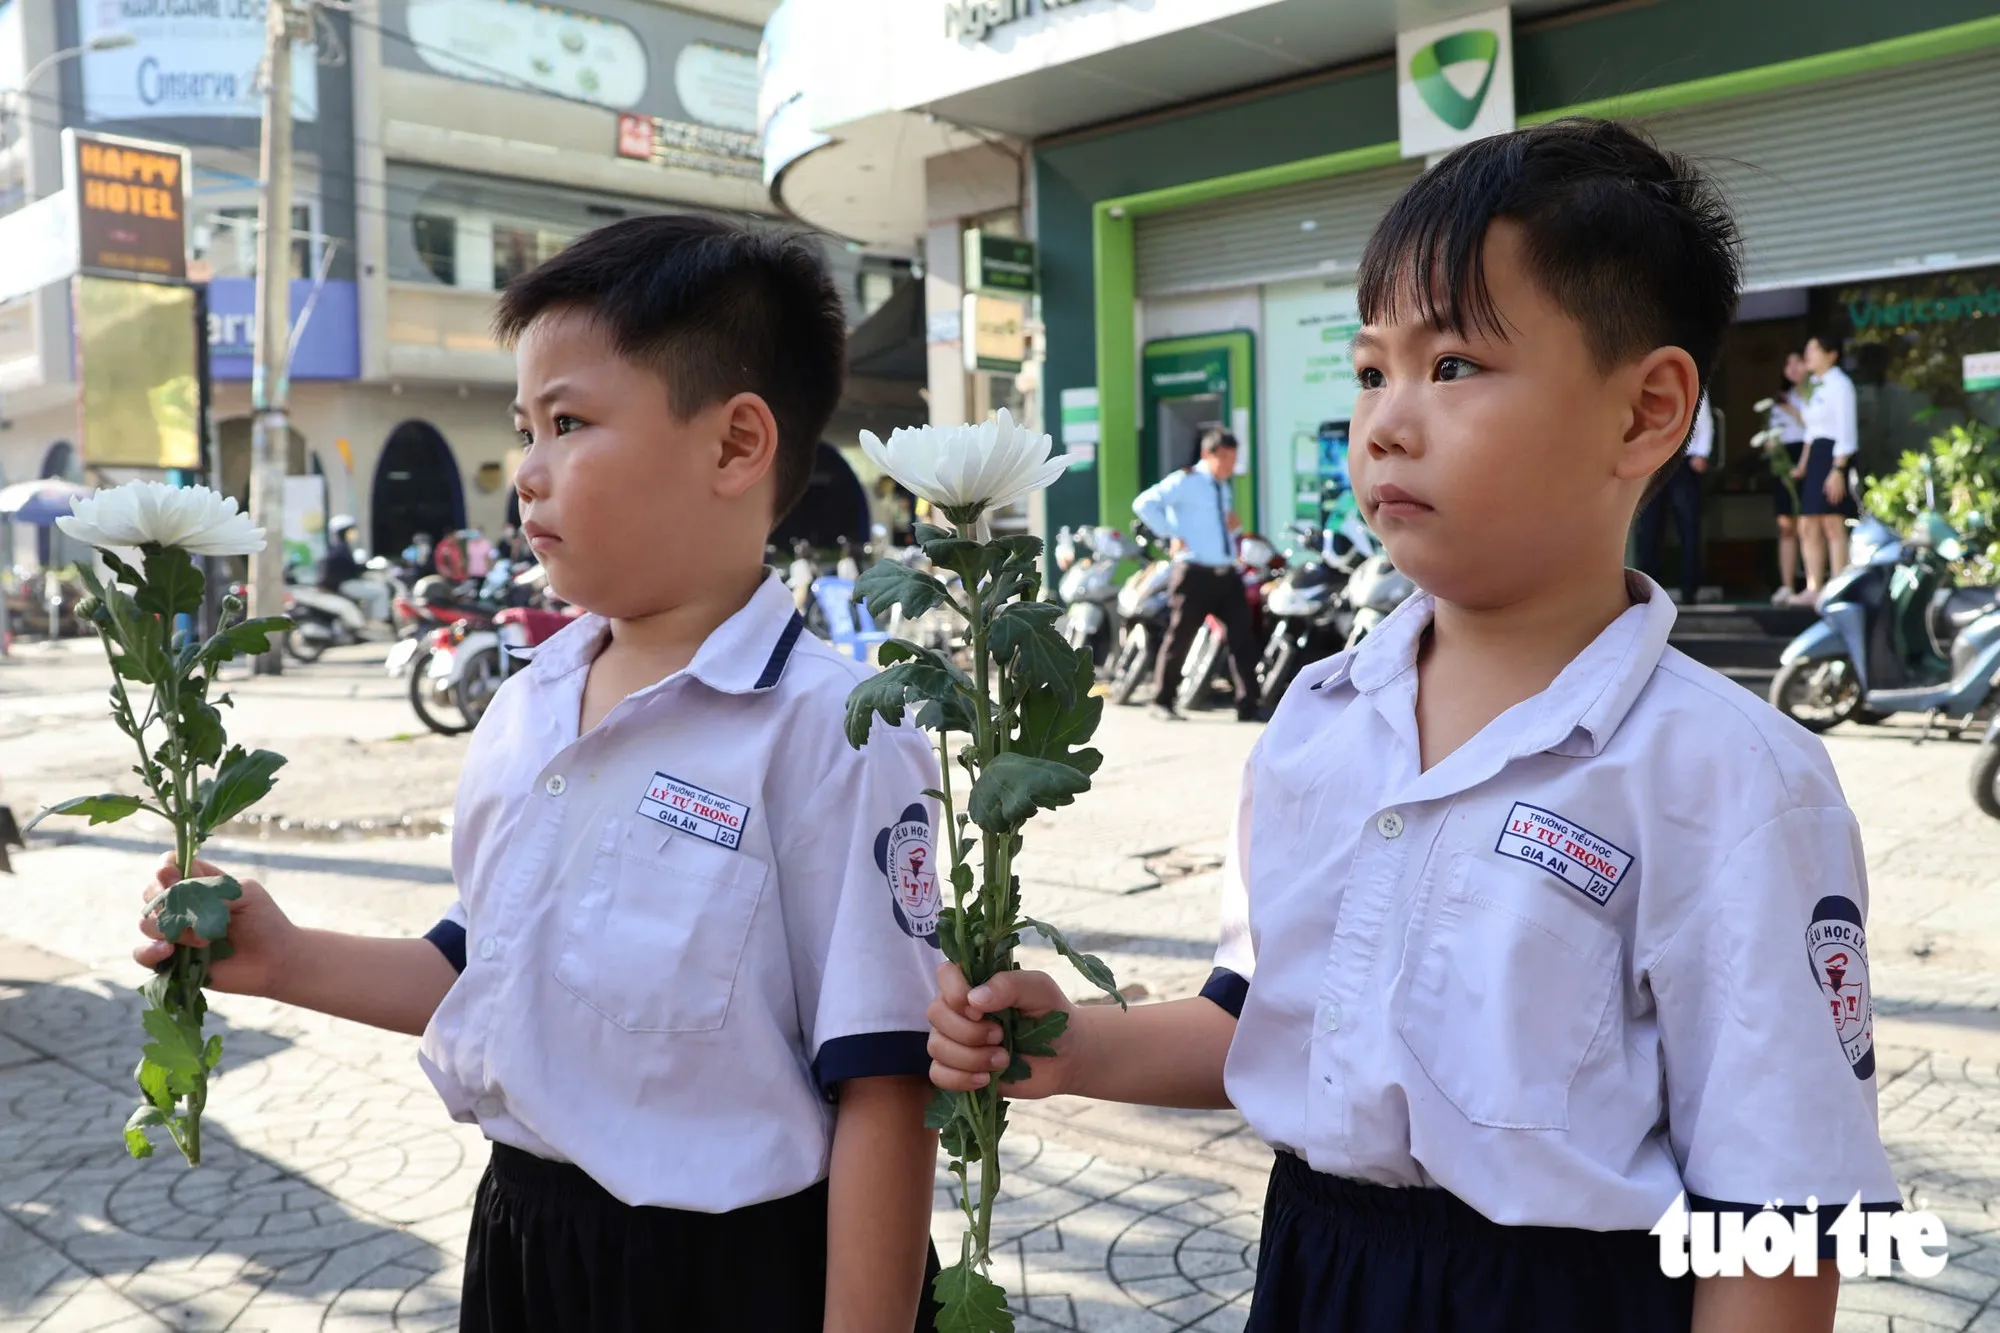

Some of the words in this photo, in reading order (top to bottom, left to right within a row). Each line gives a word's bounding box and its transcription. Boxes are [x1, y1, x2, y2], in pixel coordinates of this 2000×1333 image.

[80, 144, 179, 187] HAPPY
[84, 179, 179, 221] HOTEL
[651, 787, 669, 801] LÝ
[672, 794, 692, 810] TỰ
[692, 801, 739, 827] TRỌNG
[666, 782, 696, 799] TRƯỜNG
[714, 801, 731, 812] HỌC
[659, 810, 678, 825] GIA
[911, 825, 929, 839] HỌC
[720, 831, 735, 844] 2/3
[1512, 819, 1534, 835] LÝ
[1537, 827, 1563, 847] TỰ
[1564, 840, 1618, 879] TRỌNG
[1529, 812, 1569, 835] TRƯỜNG
[1571, 830, 1592, 846] TIỂU
[1592, 842, 1612, 858] HỌC
[1521, 845, 1544, 862] GIA
[1547, 857, 1568, 875] AN
[1590, 880, 1608, 897] 2/3
[1824, 925, 1851, 941] HỌC
[1850, 1045, 1861, 1061] 12
